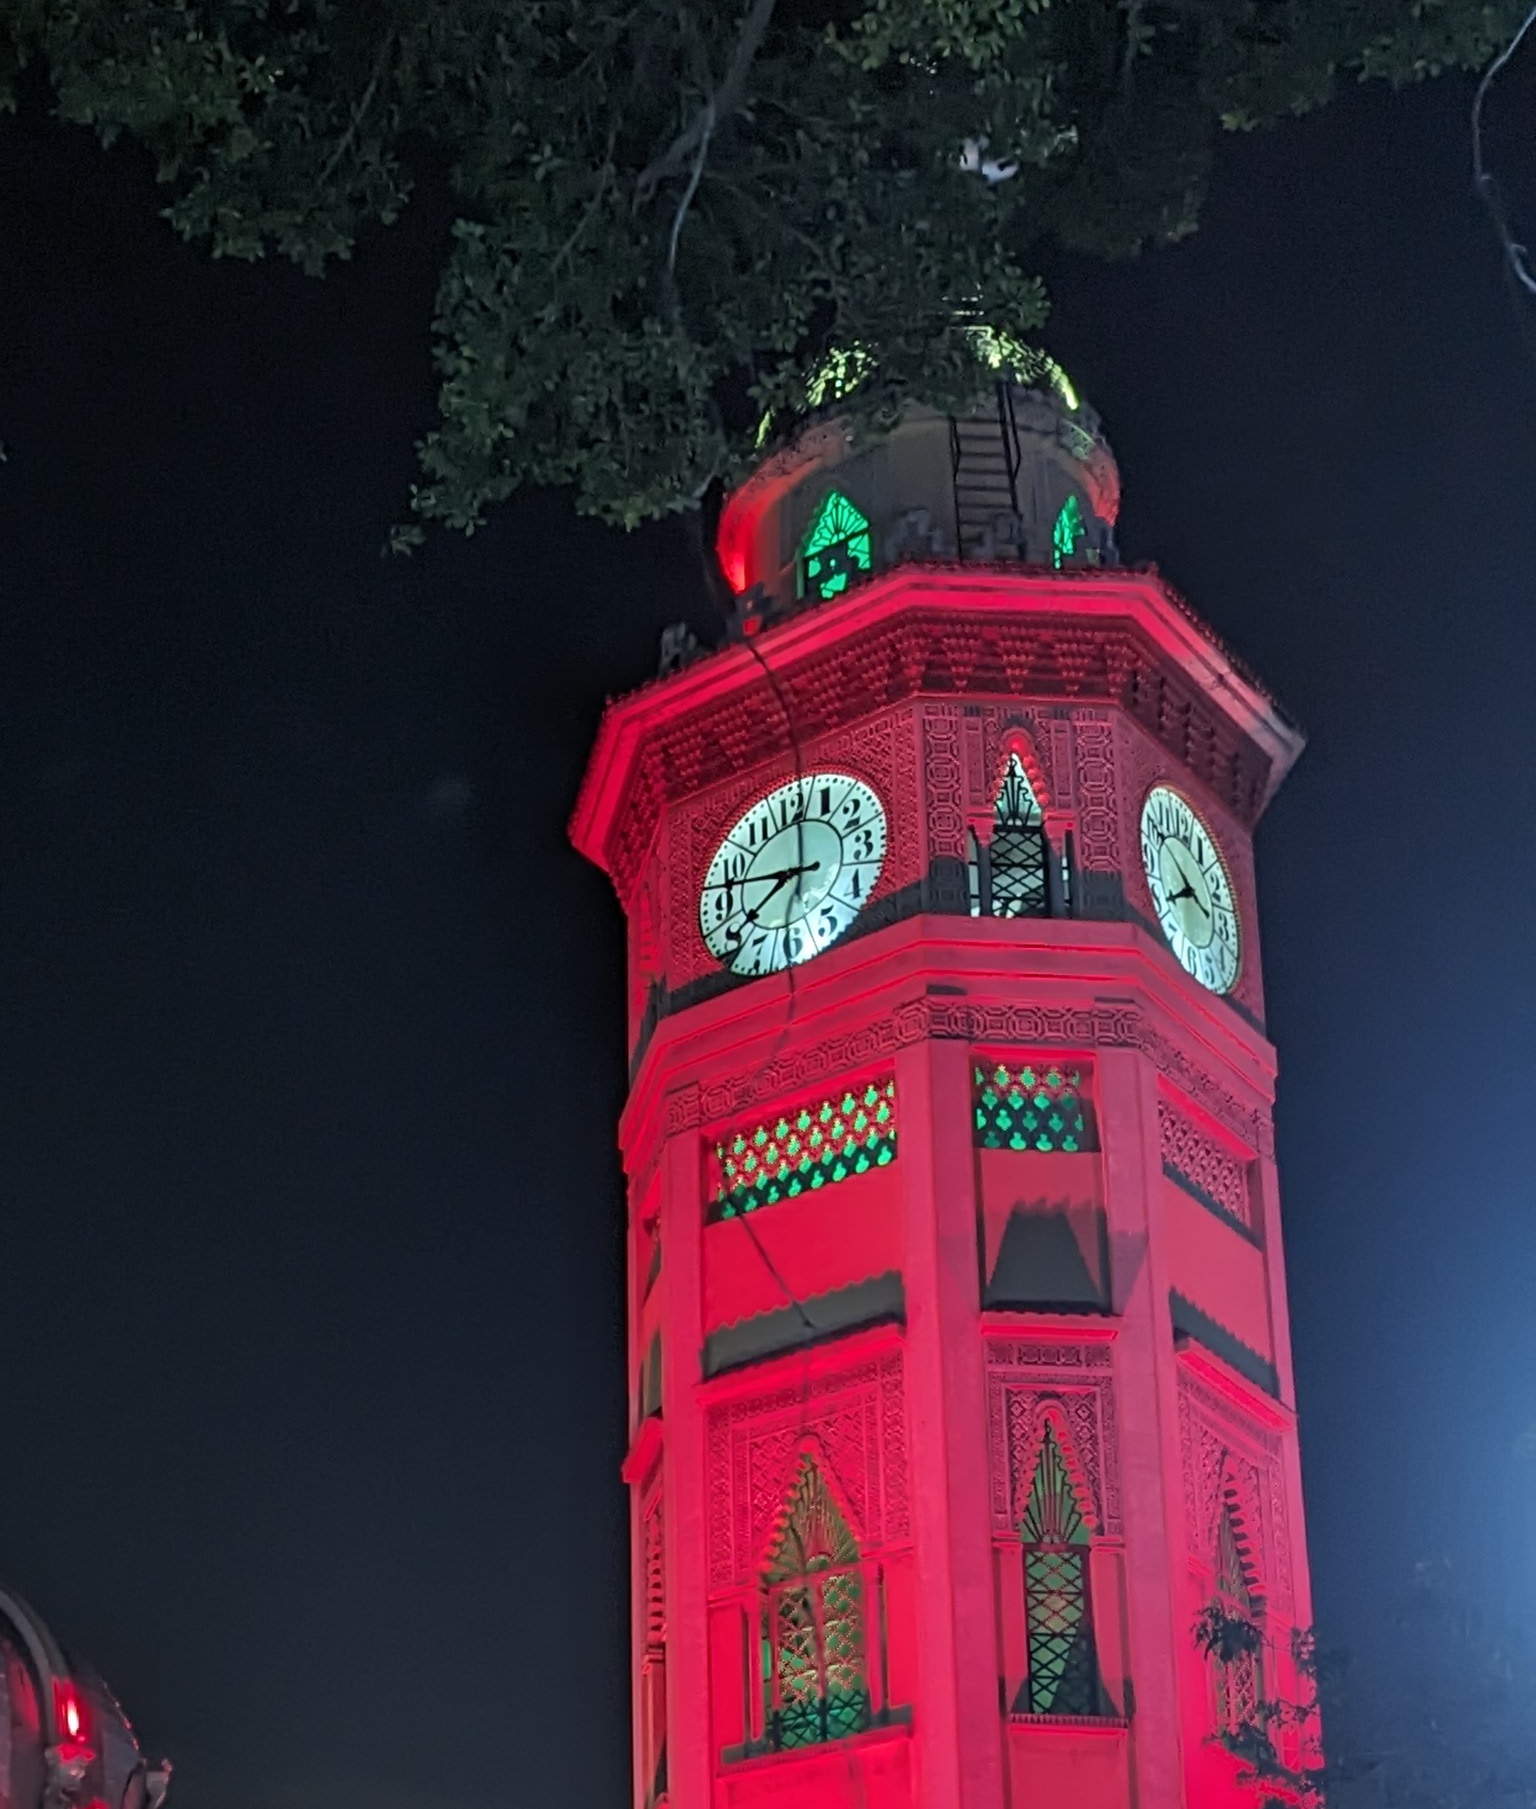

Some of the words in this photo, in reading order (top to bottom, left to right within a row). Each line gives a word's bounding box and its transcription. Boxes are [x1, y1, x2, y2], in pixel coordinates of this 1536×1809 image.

[779, 792, 804, 827] 12
[819, 787, 831, 818] 1
[843, 798, 861, 831] 2
[1158, 801, 1170, 833] 11
[748, 816, 769, 847] 11
[1175, 807, 1189, 843] 12
[853, 829, 874, 860] 3
[1143, 843, 1154, 873] 9
[1196, 836, 1204, 866] 1
[723, 852, 745, 883] 10
[843, 868, 864, 900] 4
[1210, 872, 1221, 903] 2
[715, 890, 733, 921] 9
[818, 905, 838, 937] 5
[724, 921, 742, 951] 8
[1218, 912, 1229, 942] 3
[752, 933, 769, 970] 7
[783, 927, 803, 959] 6
